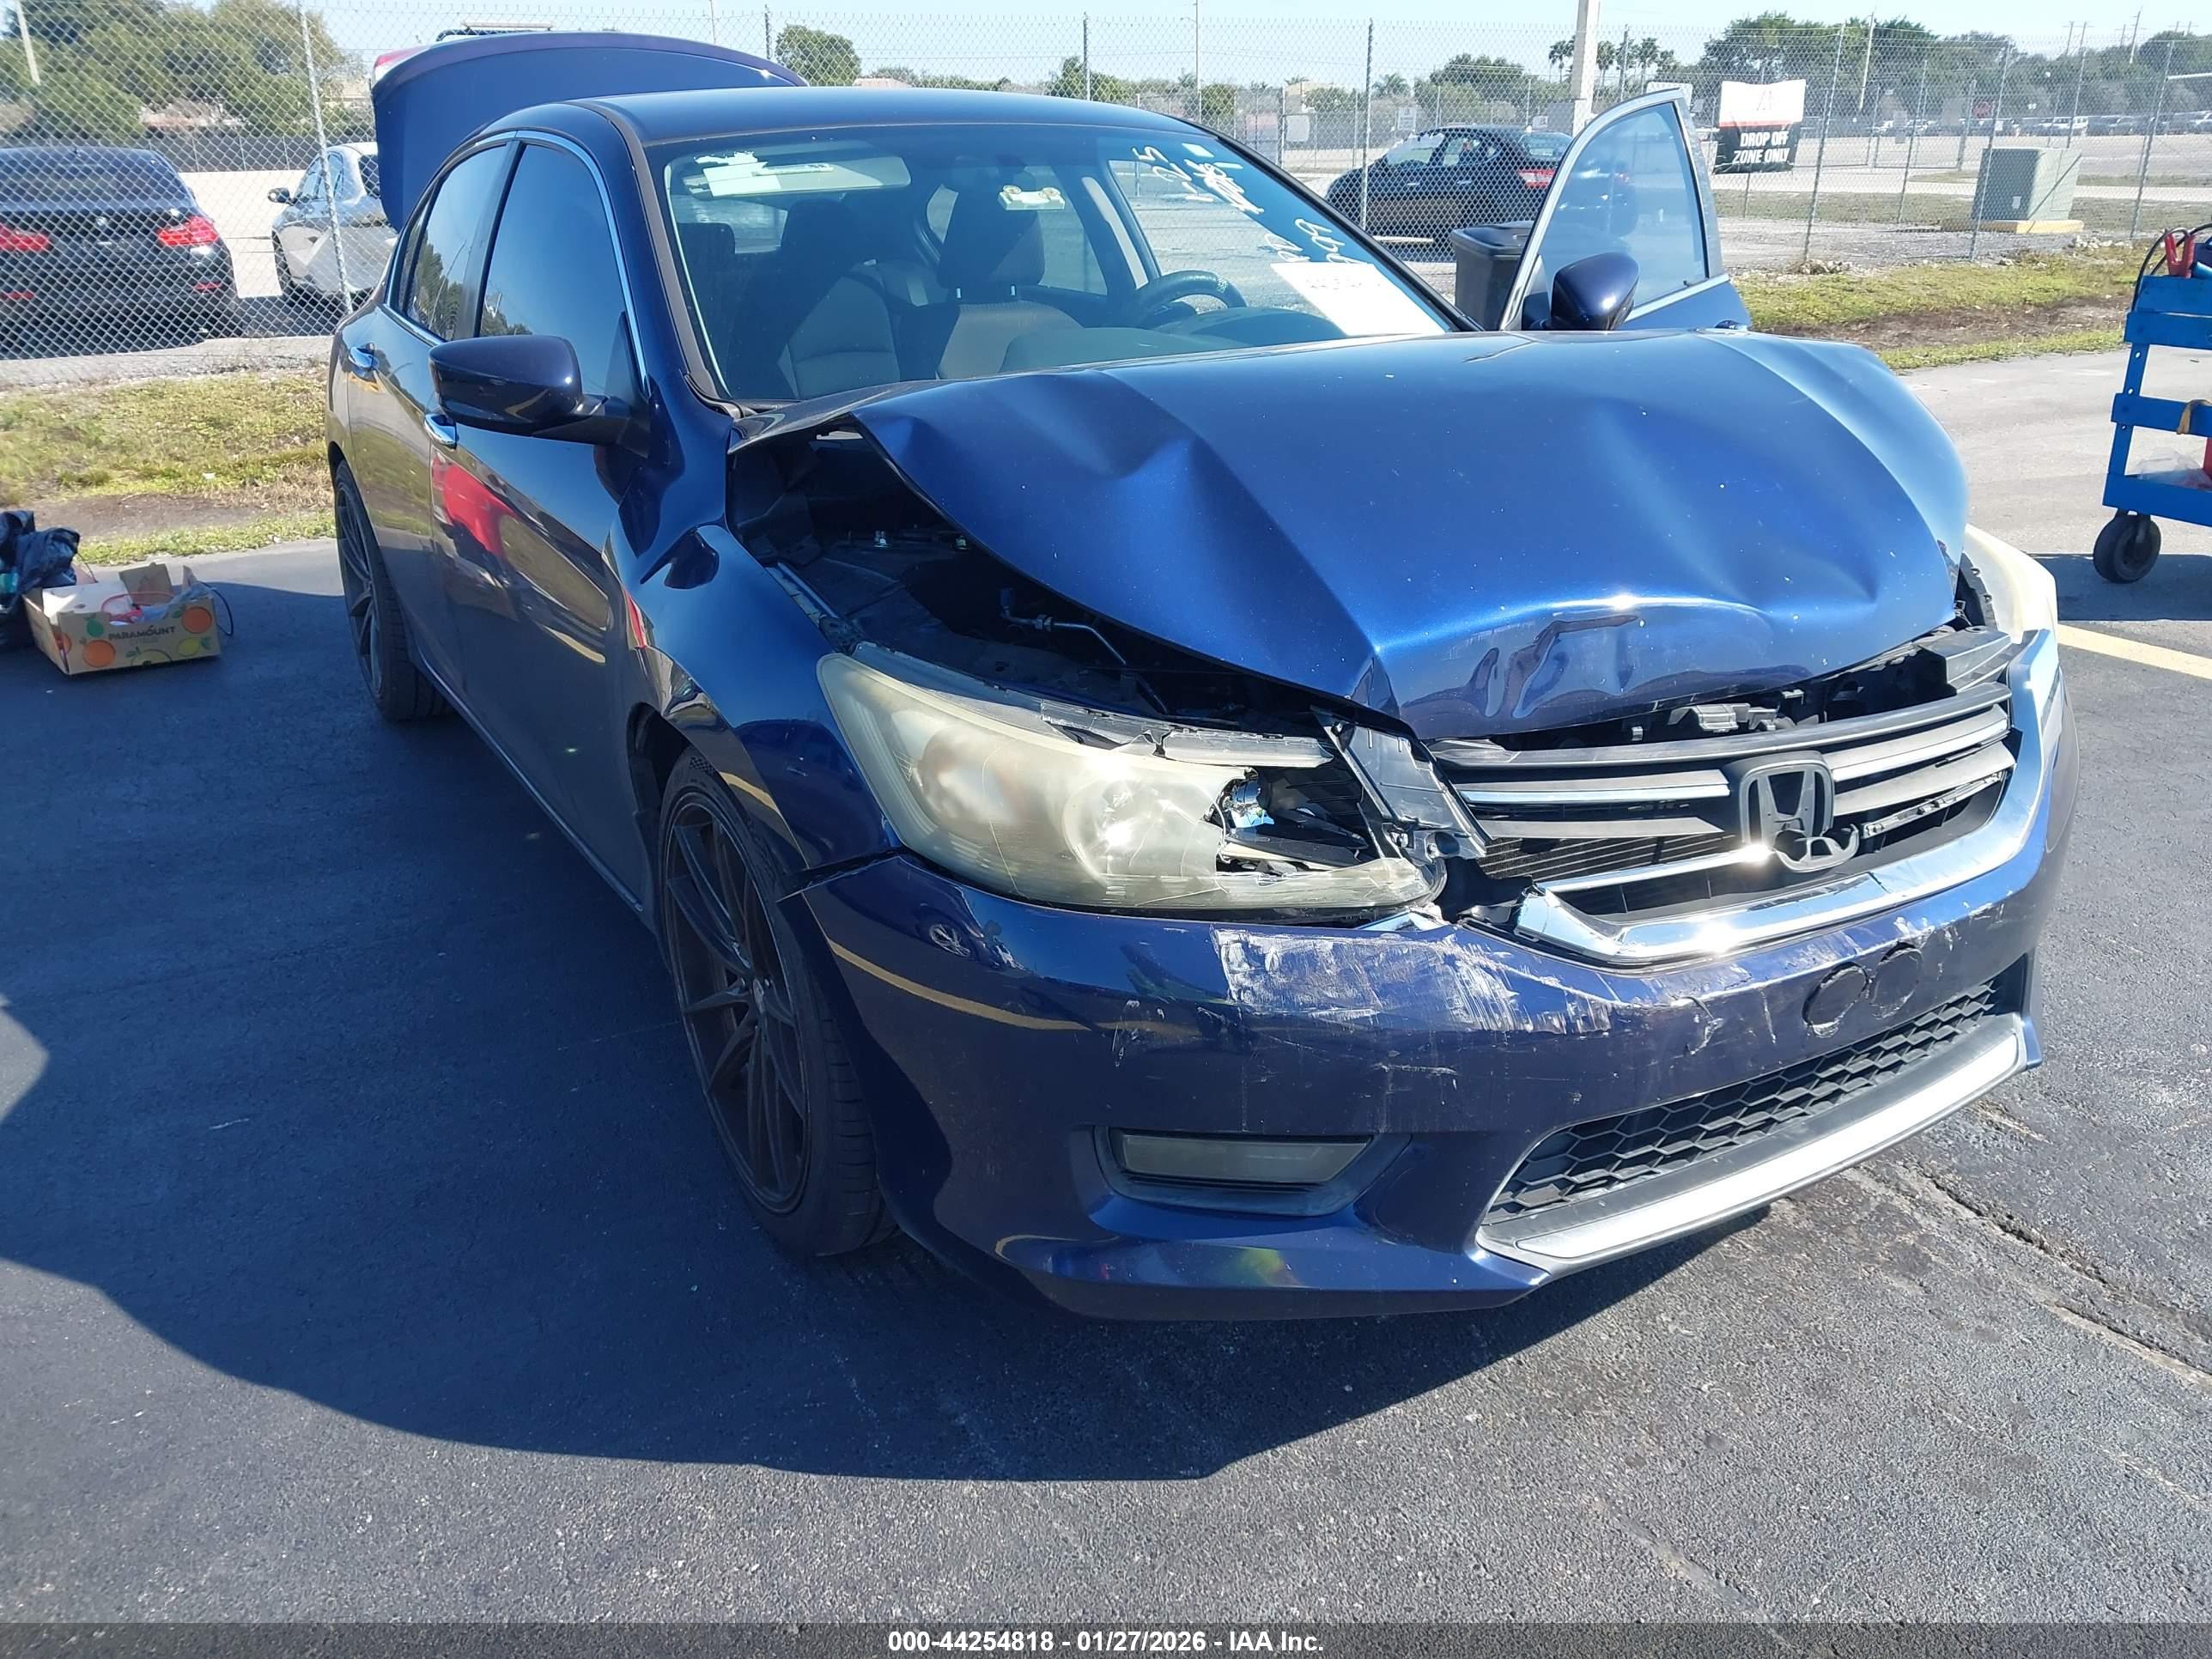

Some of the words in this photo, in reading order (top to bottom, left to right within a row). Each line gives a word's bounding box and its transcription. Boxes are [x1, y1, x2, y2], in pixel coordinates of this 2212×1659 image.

[1740, 131, 1770, 147] DROP
[1771, 131, 1790, 145] OFF
[1732, 149, 1763, 165] ZONE
[1764, 148, 1790, 163] ONLY
